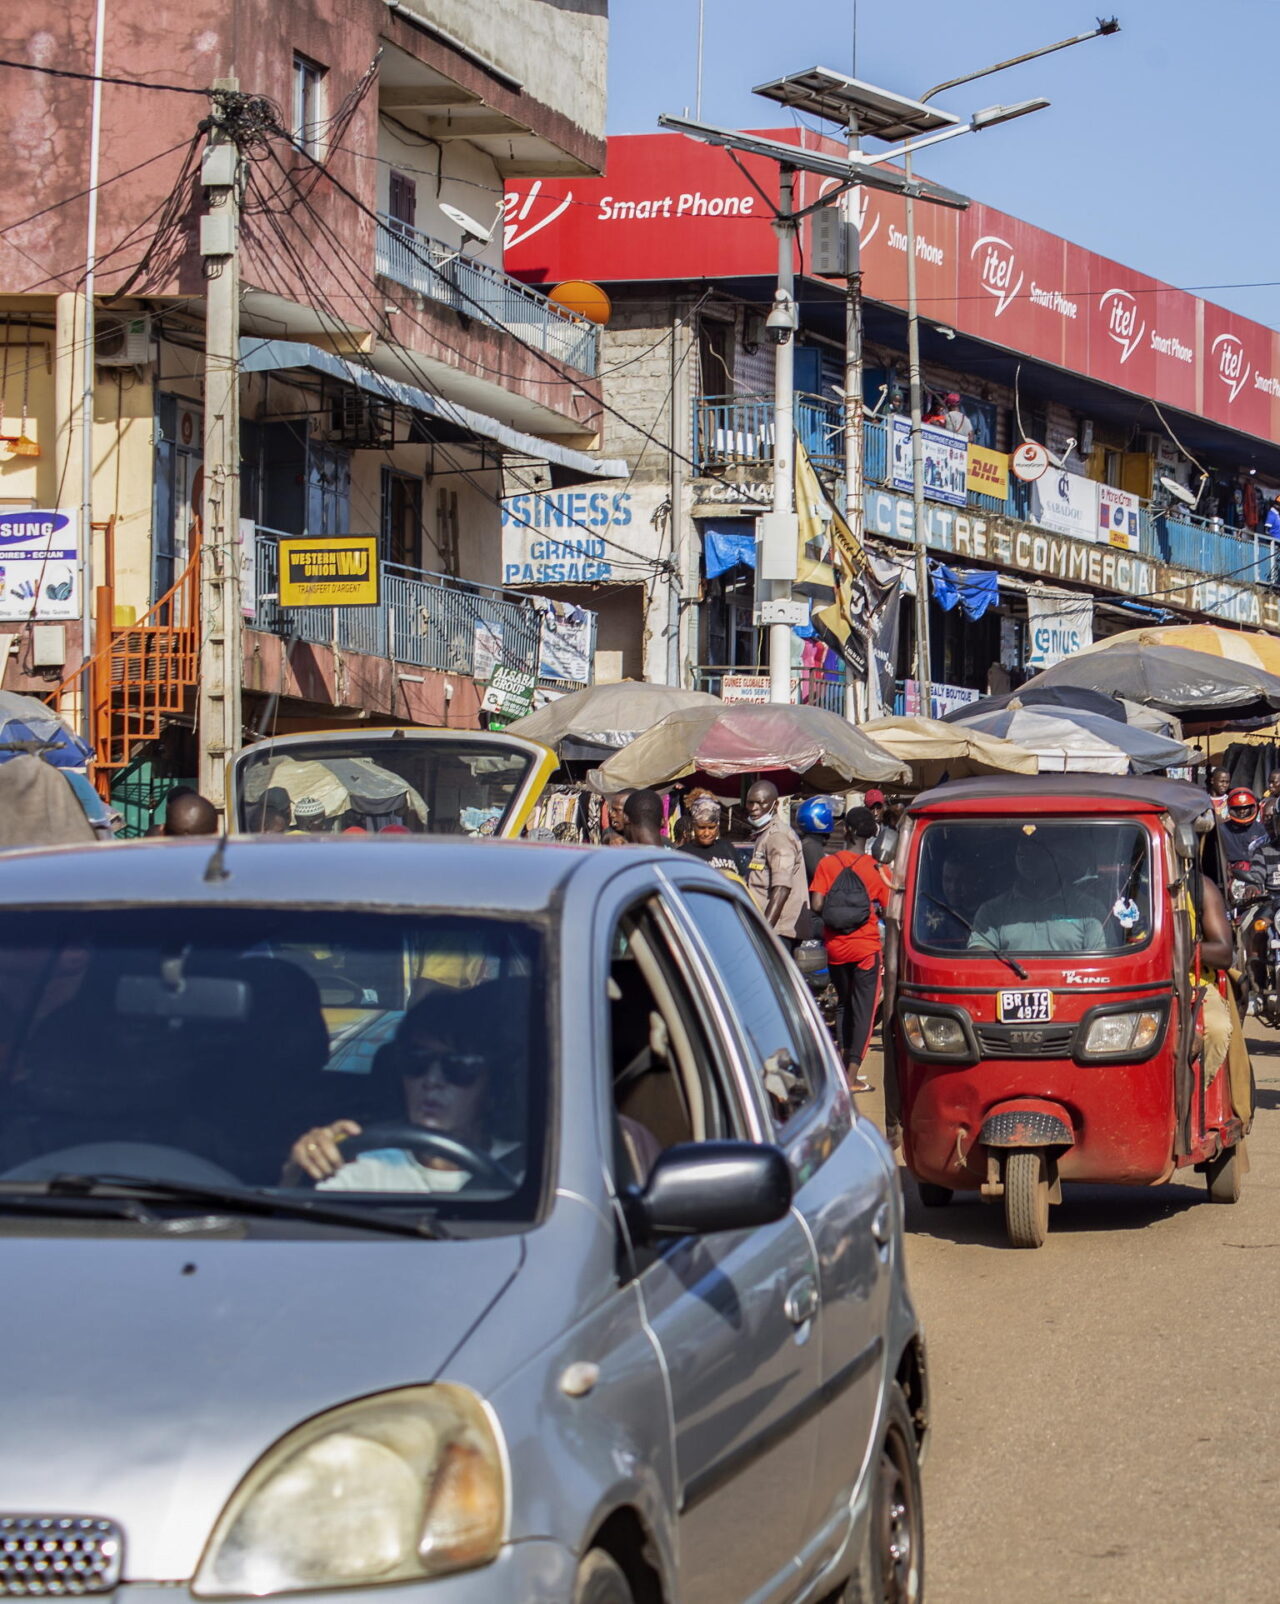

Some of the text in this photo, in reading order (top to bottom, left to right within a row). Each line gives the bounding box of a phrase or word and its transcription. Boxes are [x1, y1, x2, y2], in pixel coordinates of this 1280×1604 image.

[597, 192, 755, 221] Smart Phone
[915, 234, 944, 266] Phone
[982, 246, 1015, 289] itel
[1029, 281, 1078, 319] Smart Phone
[1109, 297, 1137, 337] itel
[1150, 329, 1194, 364] Smart Phone
[1219, 342, 1244, 378] itel
[1254, 370, 1273, 395] Smart
[971, 458, 1000, 483] DHL
[290, 552, 337, 566] WESTERN
[530, 539, 606, 560] GRAND
[876, 495, 987, 557] CENTRE
[1016, 531, 1161, 601] COMMERCIAL
[1192, 578, 1261, 626] AFRICA
[304, 563, 337, 577] UNION
[506, 563, 613, 583] PASSAGE
[297, 583, 362, 594] TRANSFERT D'ARGENT
[492, 677, 526, 696] GROUP
[493, 665, 536, 689] ALSABA
[945, 687, 973, 703] BOUTIQUE
[1010, 1031, 1043, 1043] TVS
